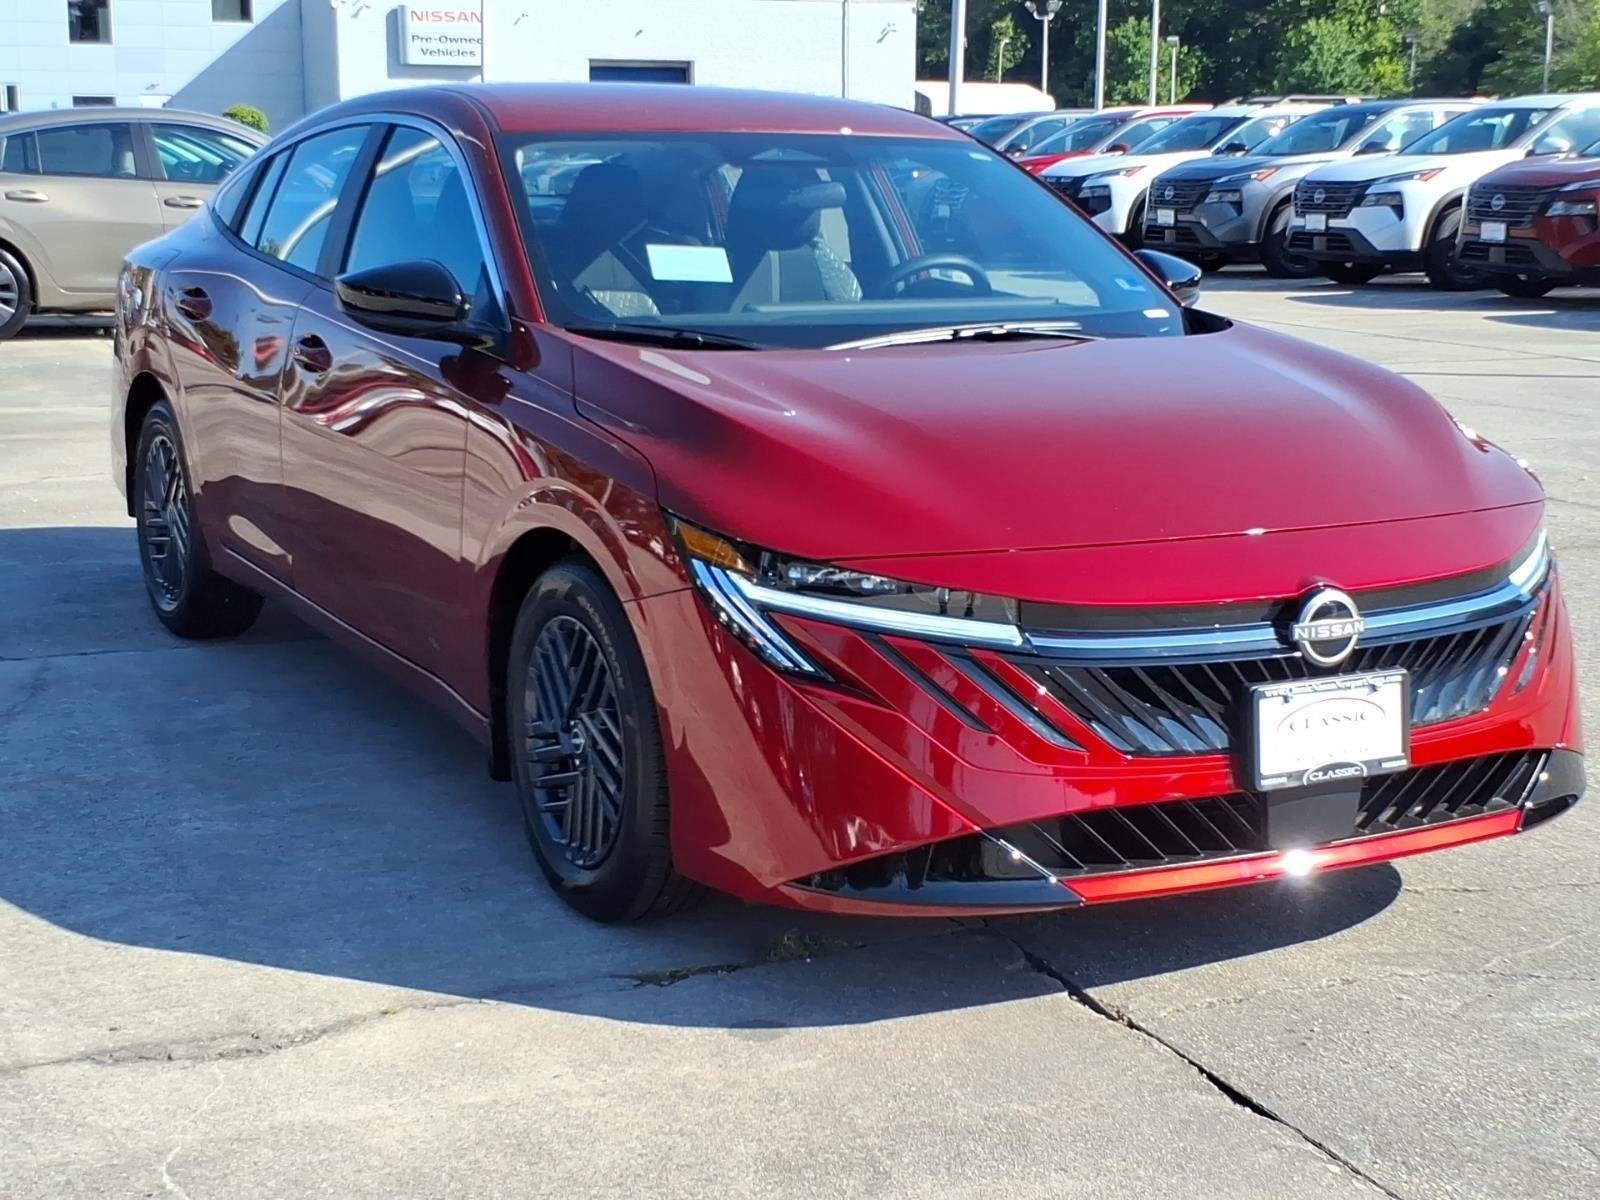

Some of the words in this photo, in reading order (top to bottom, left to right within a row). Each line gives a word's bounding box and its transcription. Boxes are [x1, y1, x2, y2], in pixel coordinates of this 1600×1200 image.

[410, 10, 482, 22] NISSAN
[420, 47, 476, 57] Vehicles
[1293, 619, 1365, 640] NISSAN
[1288, 711, 1368, 732] CLASSIC
[1309, 766, 1361, 782] CLASSIC
